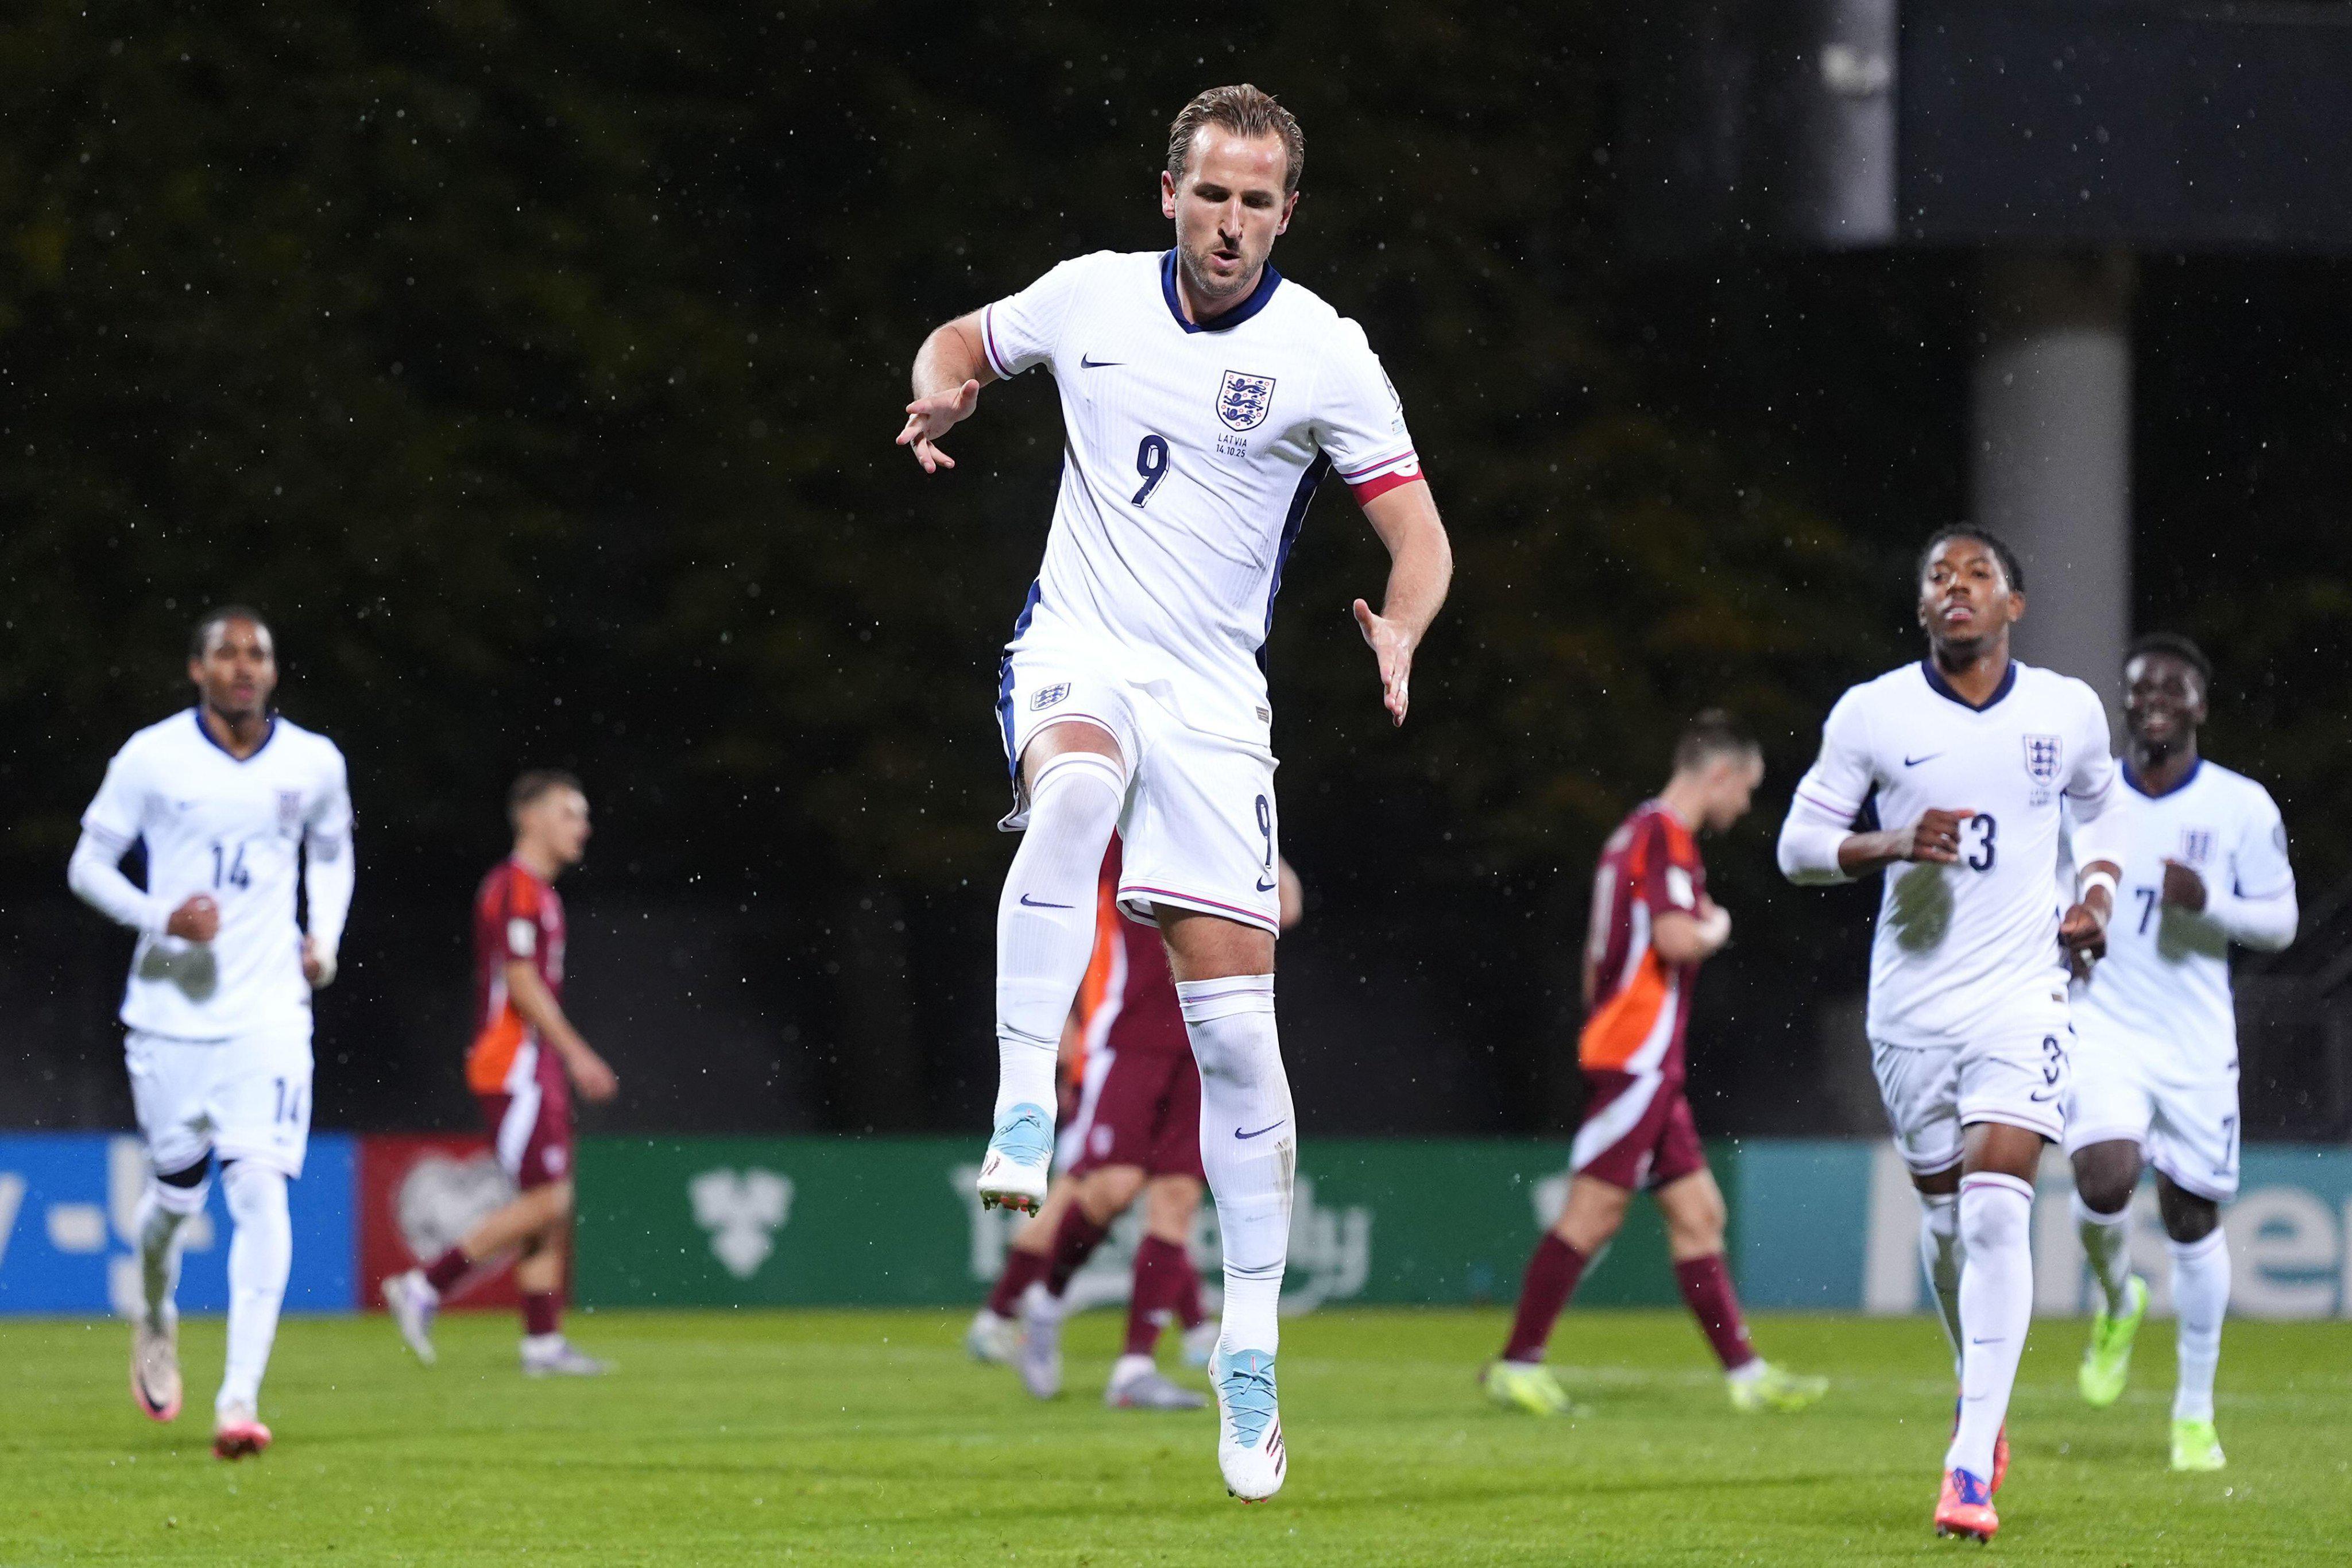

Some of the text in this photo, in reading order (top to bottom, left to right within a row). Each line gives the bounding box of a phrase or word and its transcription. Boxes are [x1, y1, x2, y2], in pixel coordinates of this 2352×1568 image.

[1216, 444, 1246, 458] 14.10.25
[1218, 433, 1247, 447] LATVIA
[1132, 435, 1170, 508] 9
[1255, 794, 1271, 869] 9
[1969, 813, 1997, 872] 3
[213, 840, 250, 891] 14
[2136, 886, 2156, 936] 7
[2042, 1034, 2062, 1085] 3
